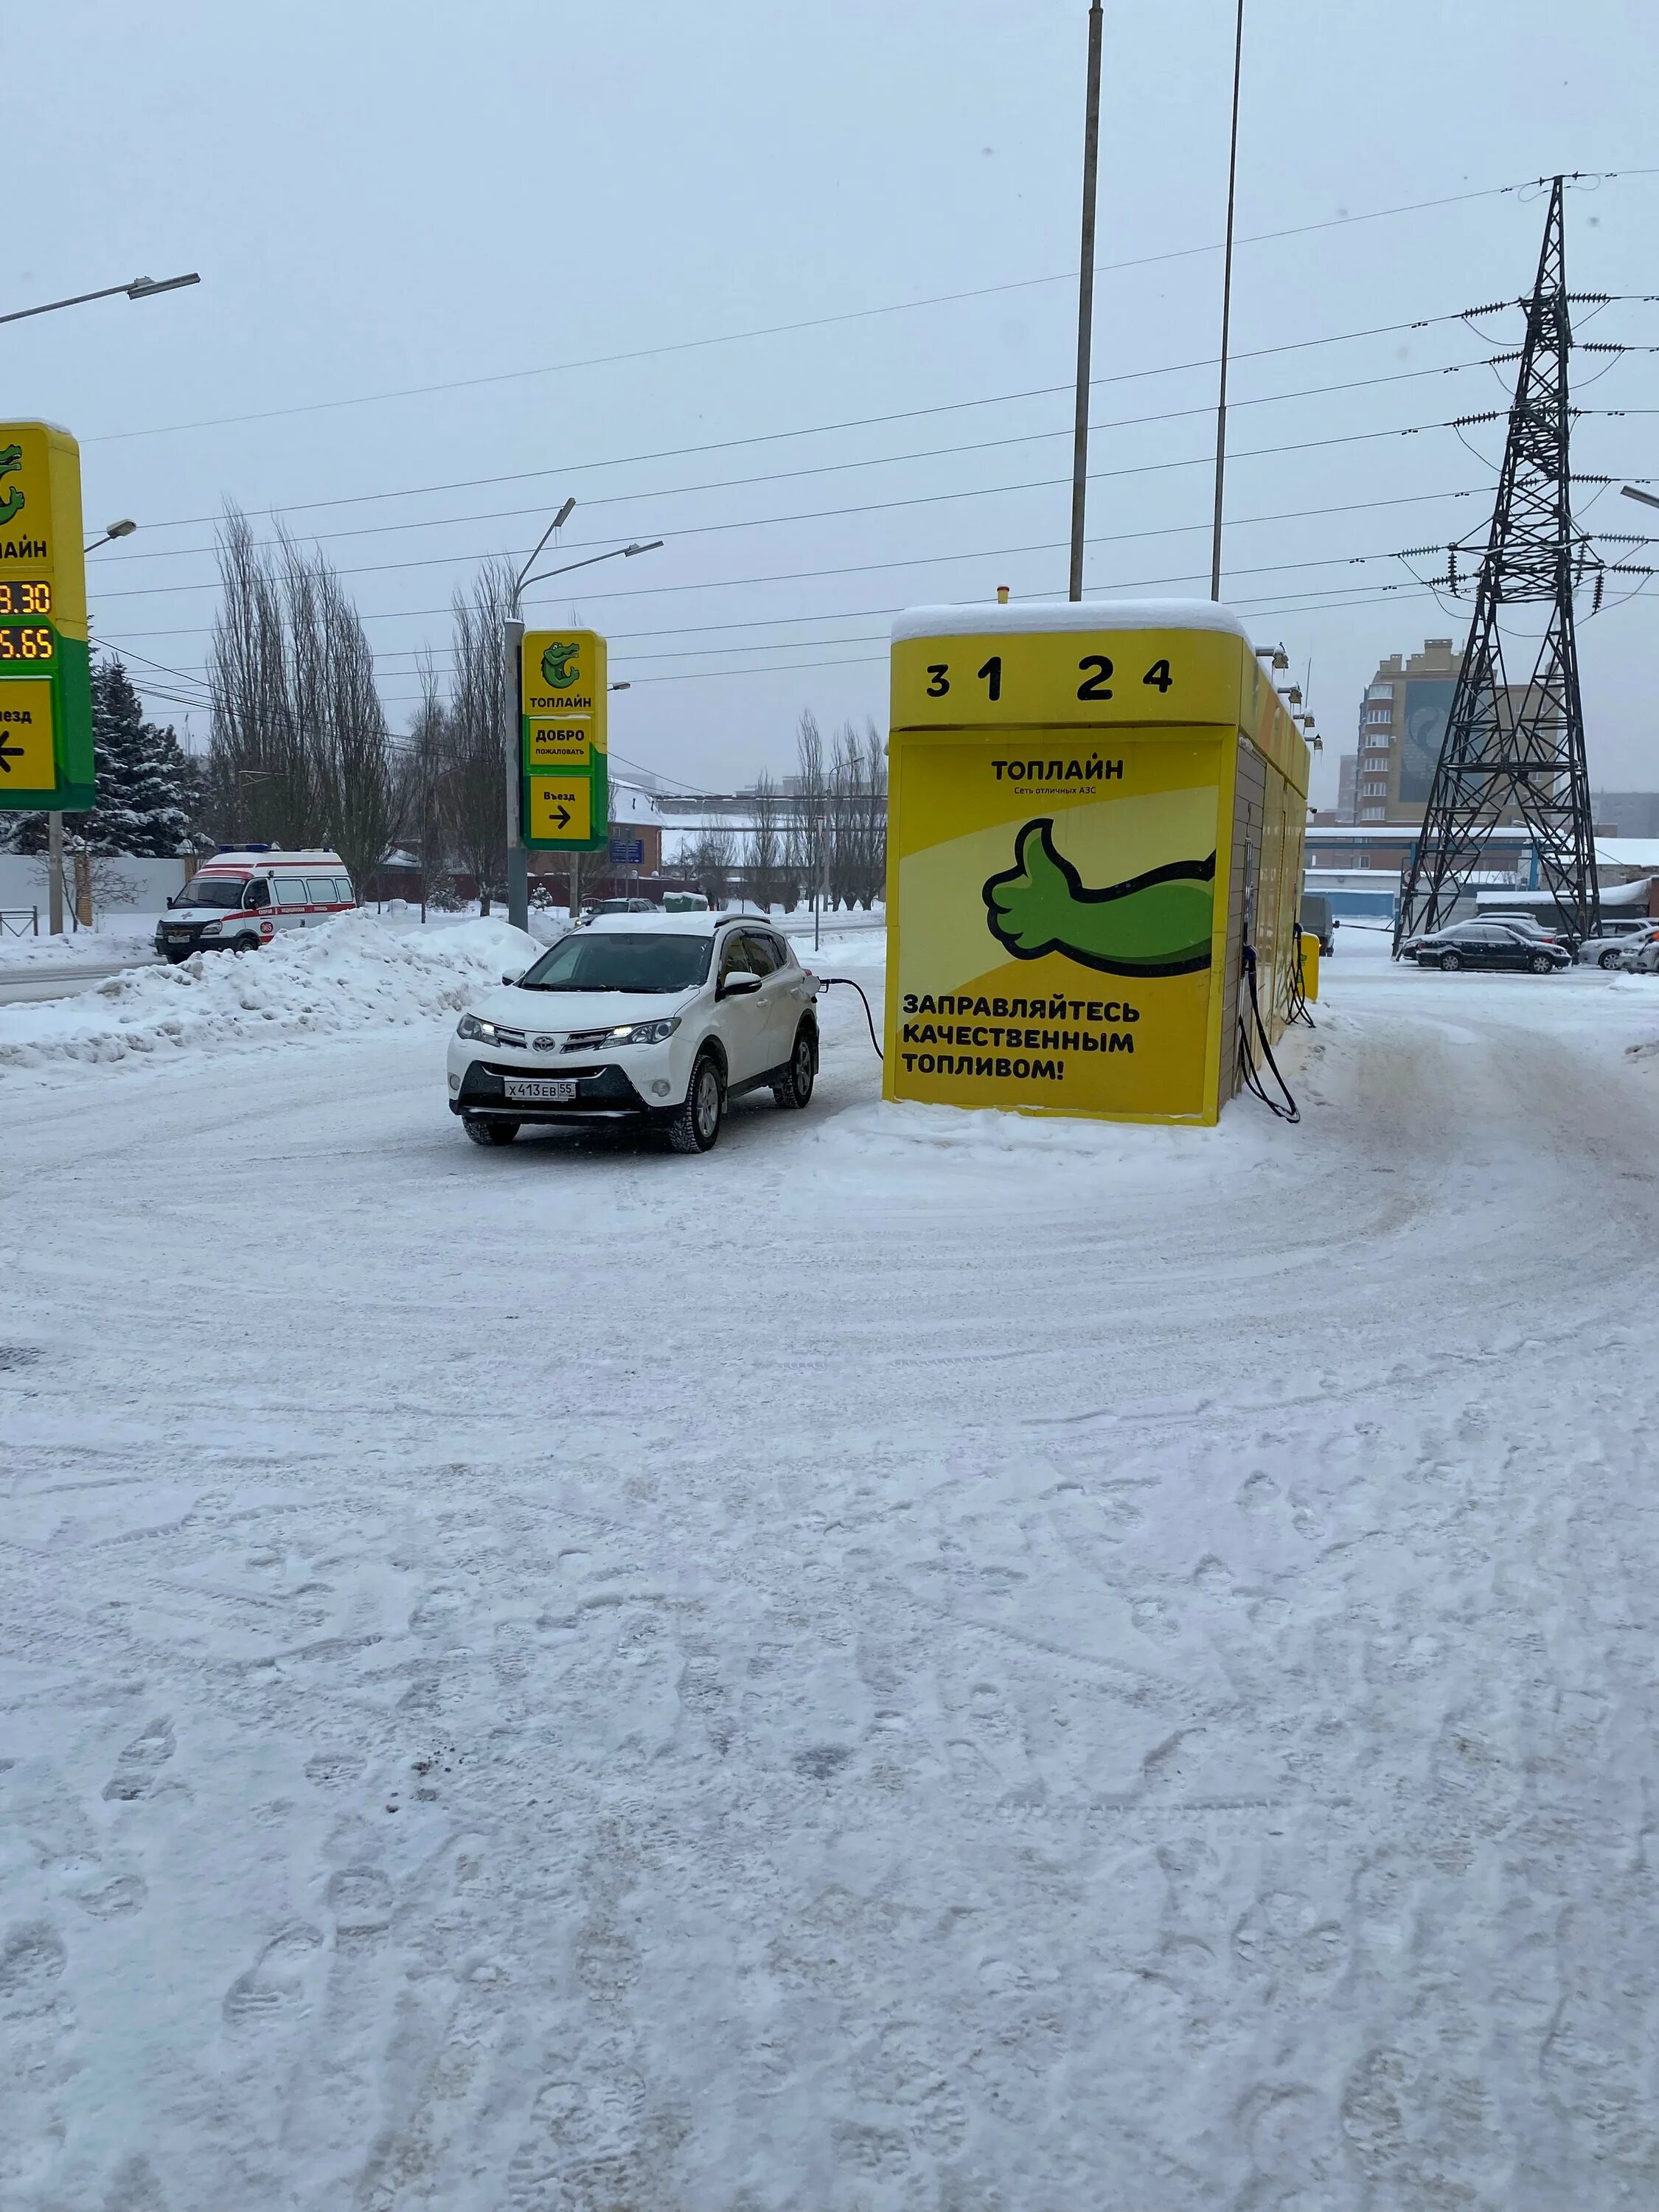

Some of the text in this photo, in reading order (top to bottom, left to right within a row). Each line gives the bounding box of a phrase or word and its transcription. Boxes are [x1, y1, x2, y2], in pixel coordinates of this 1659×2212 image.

[0, 534, 46, 558] АЙН
[0, 629, 52, 658] 5.65
[926, 655, 1172, 701] 3 1 2 4
[529, 694, 591, 708] ТОПЛАЙН
[0, 711, 32, 724] езд
[535, 729, 585, 742] ДОБРО
[991, 752, 1124, 780] ТОПЛАЙН
[543, 792, 575, 801] Въезд
[902, 993, 1140, 1023] ЗАПРАВЛЯЙТЕСЬ
[903, 1023, 1134, 1054] КАЧЕСТВЕННЫМ
[902, 1054, 1064, 1080] ТОПЛИВОМ!
[560, 1084, 572, 1093] 55
